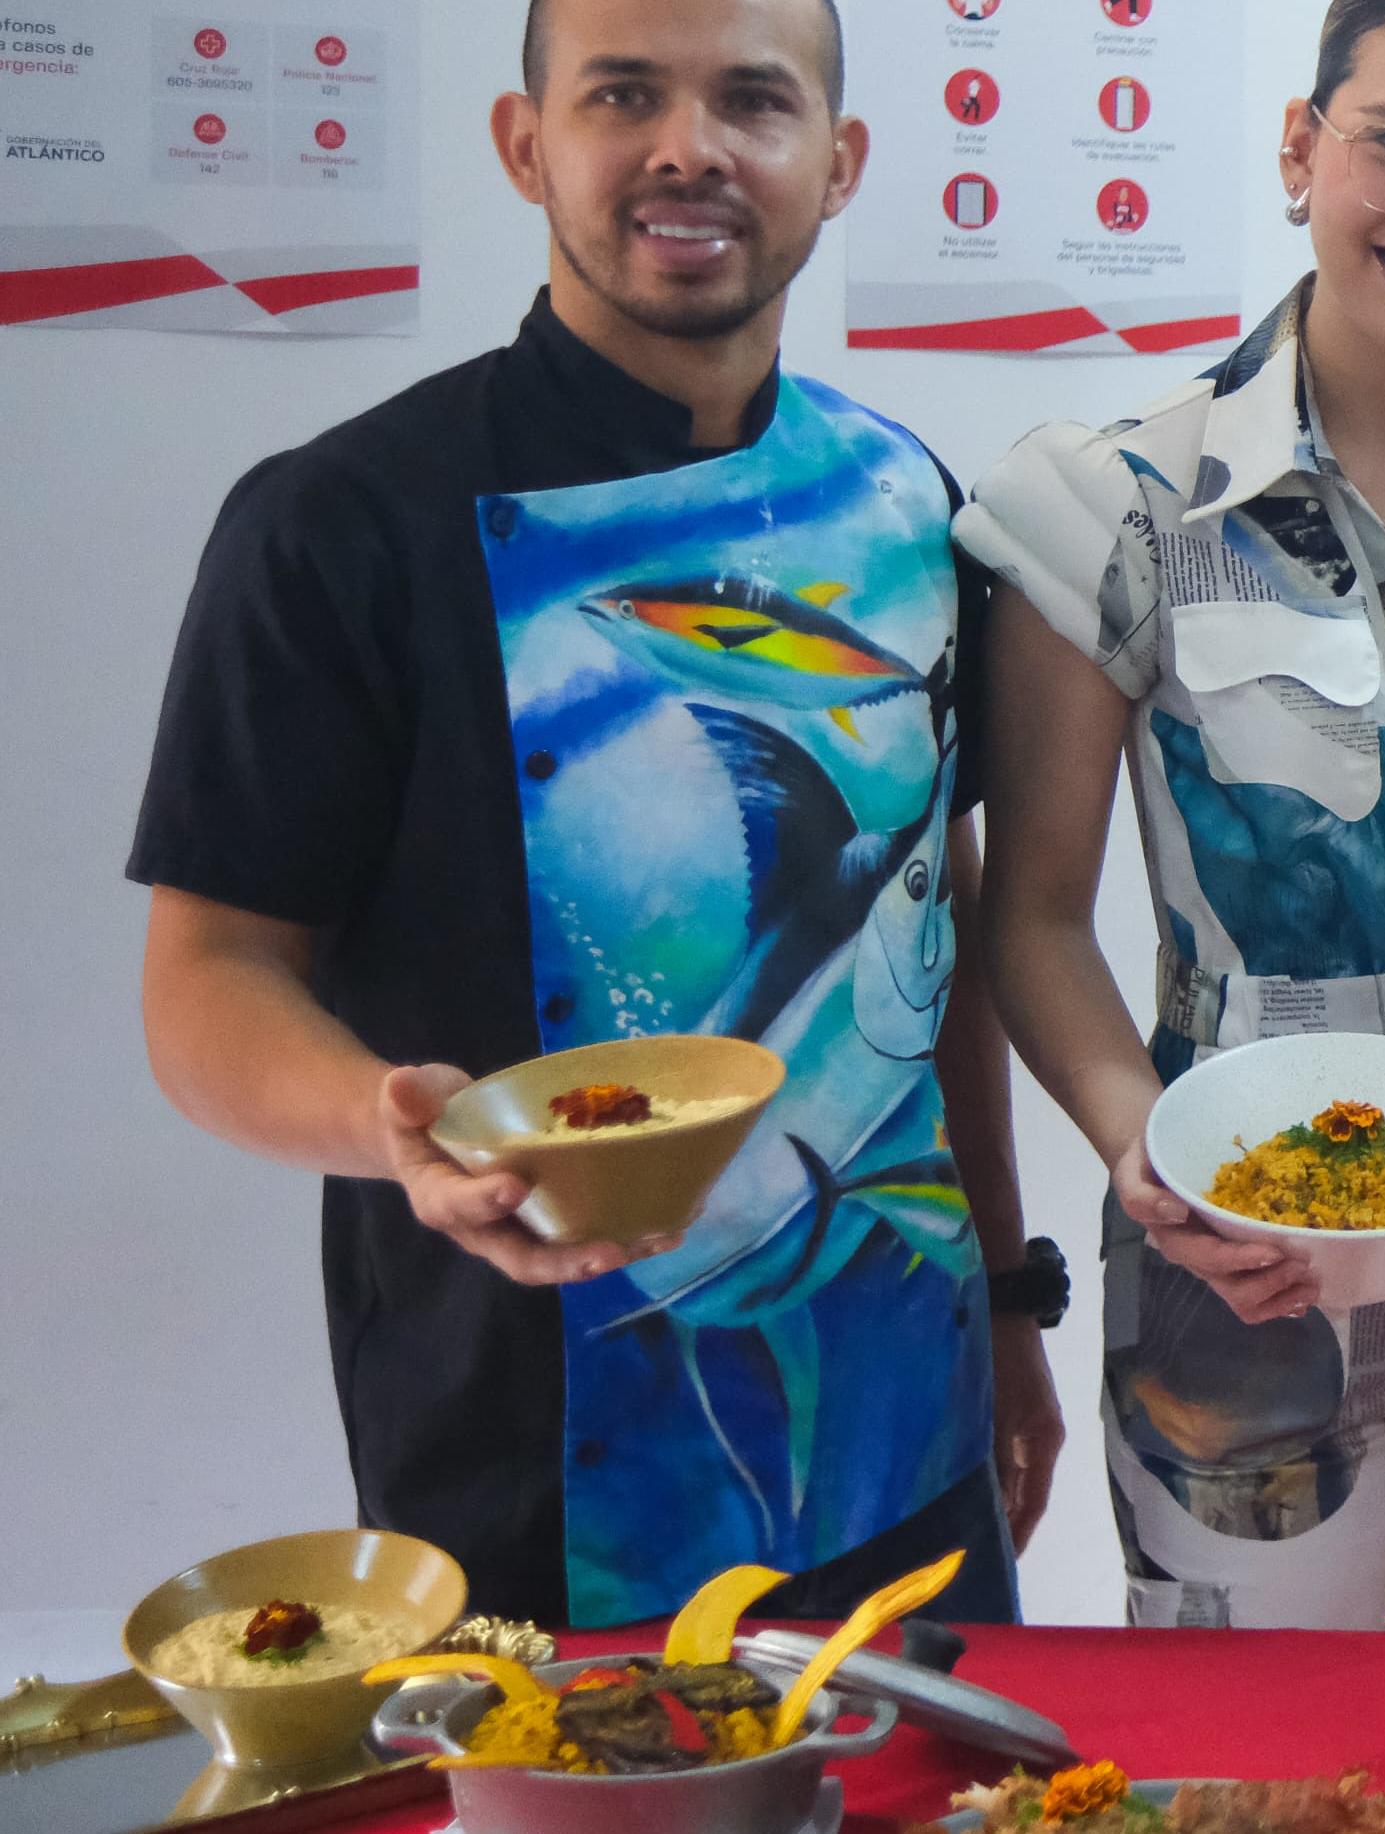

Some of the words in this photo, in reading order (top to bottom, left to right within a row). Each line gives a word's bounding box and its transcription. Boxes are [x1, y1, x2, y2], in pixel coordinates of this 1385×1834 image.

[0, 18, 56, 35] fonos
[13, 40, 66, 55] casos
[72, 42, 94, 56] de
[6, 145, 105, 162] ATLÁNTICO
